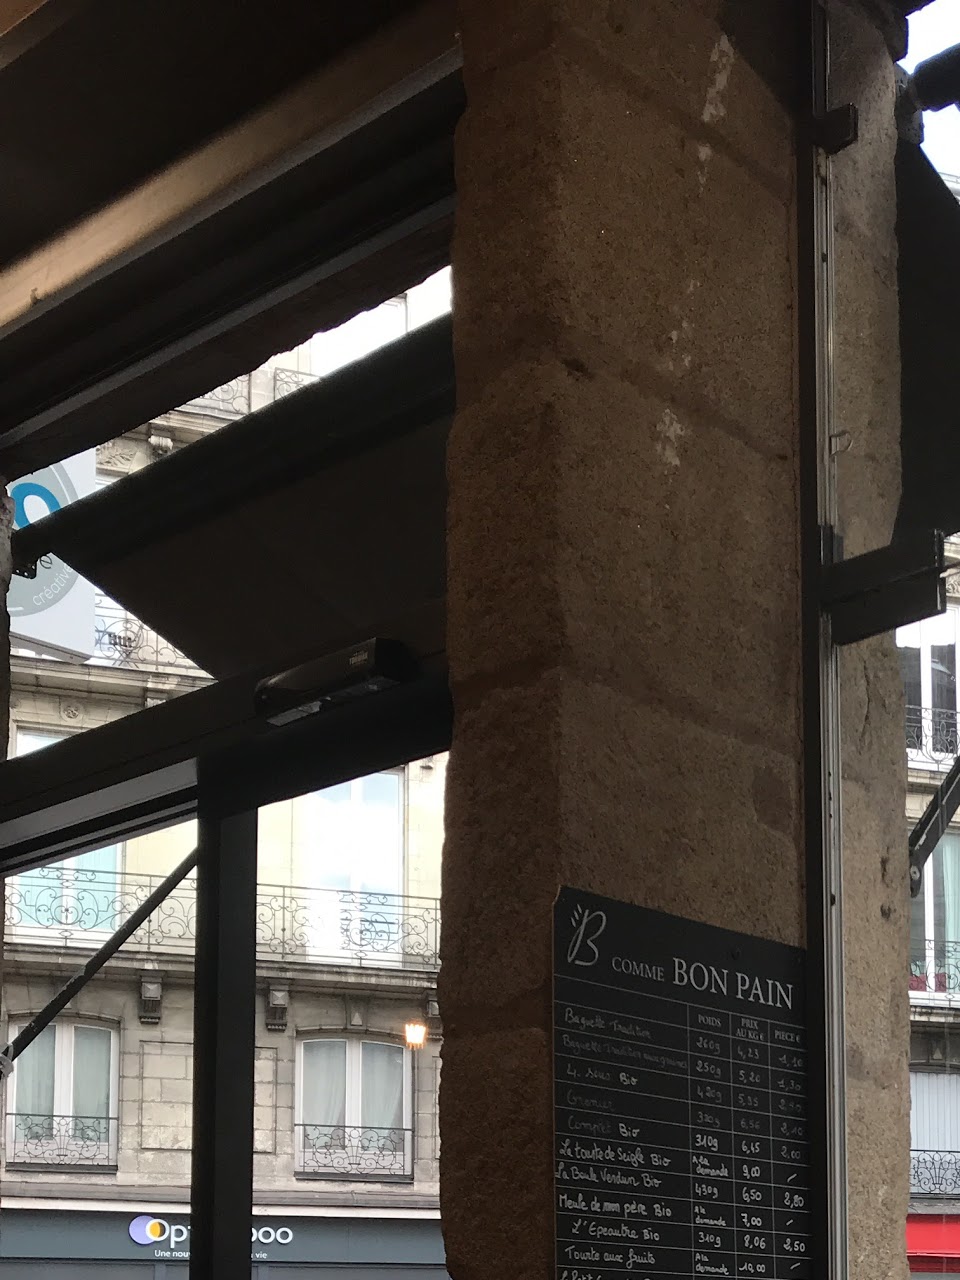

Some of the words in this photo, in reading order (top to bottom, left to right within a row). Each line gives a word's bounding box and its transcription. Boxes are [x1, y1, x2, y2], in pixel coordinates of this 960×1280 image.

[612, 957, 665, 982] COMME
[672, 957, 729, 996] BON
[735, 972, 794, 1010] PAIN
[698, 1014, 722, 1027] POIDS
[741, 1018, 759, 1030] PRIX
[736, 1028, 747, 1038] AU
[748, 1030, 759, 1040] KG
[696, 1036, 721, 1054] 260g
[696, 1061, 721, 1078] 250g
[739, 1070, 761, 1083] 5,20
[619, 1072, 638, 1085] Bio
[618, 1123, 641, 1138] Bio
[695, 1134, 719, 1152] 310g
[741, 1140, 760, 1154] 6,45
[780, 1145, 801, 1159] 2,00
[650, 1153, 672, 1166] Bio
[742, 1164, 761, 1179] 9,00
[641, 1173, 662, 1188] Bio
[695, 1183, 719, 1199] 430g
[742, 1186, 762, 1203] 6,50
[590, 1195, 601, 1212] de
[653, 1202, 672, 1217] Bio
[740, 1213, 762, 1227] 7,00
[642, 1227, 660, 1241] Bio
[698, 1231, 722, 1248] 310g
[744, 1234, 766, 1250] 8,06
[783, 1238, 806, 1252] 2,50
[154, 1250, 172, 1258] Une
[564, 1245, 600, 1261] Tourte
[739, 1262, 766, 1273] 10,00
